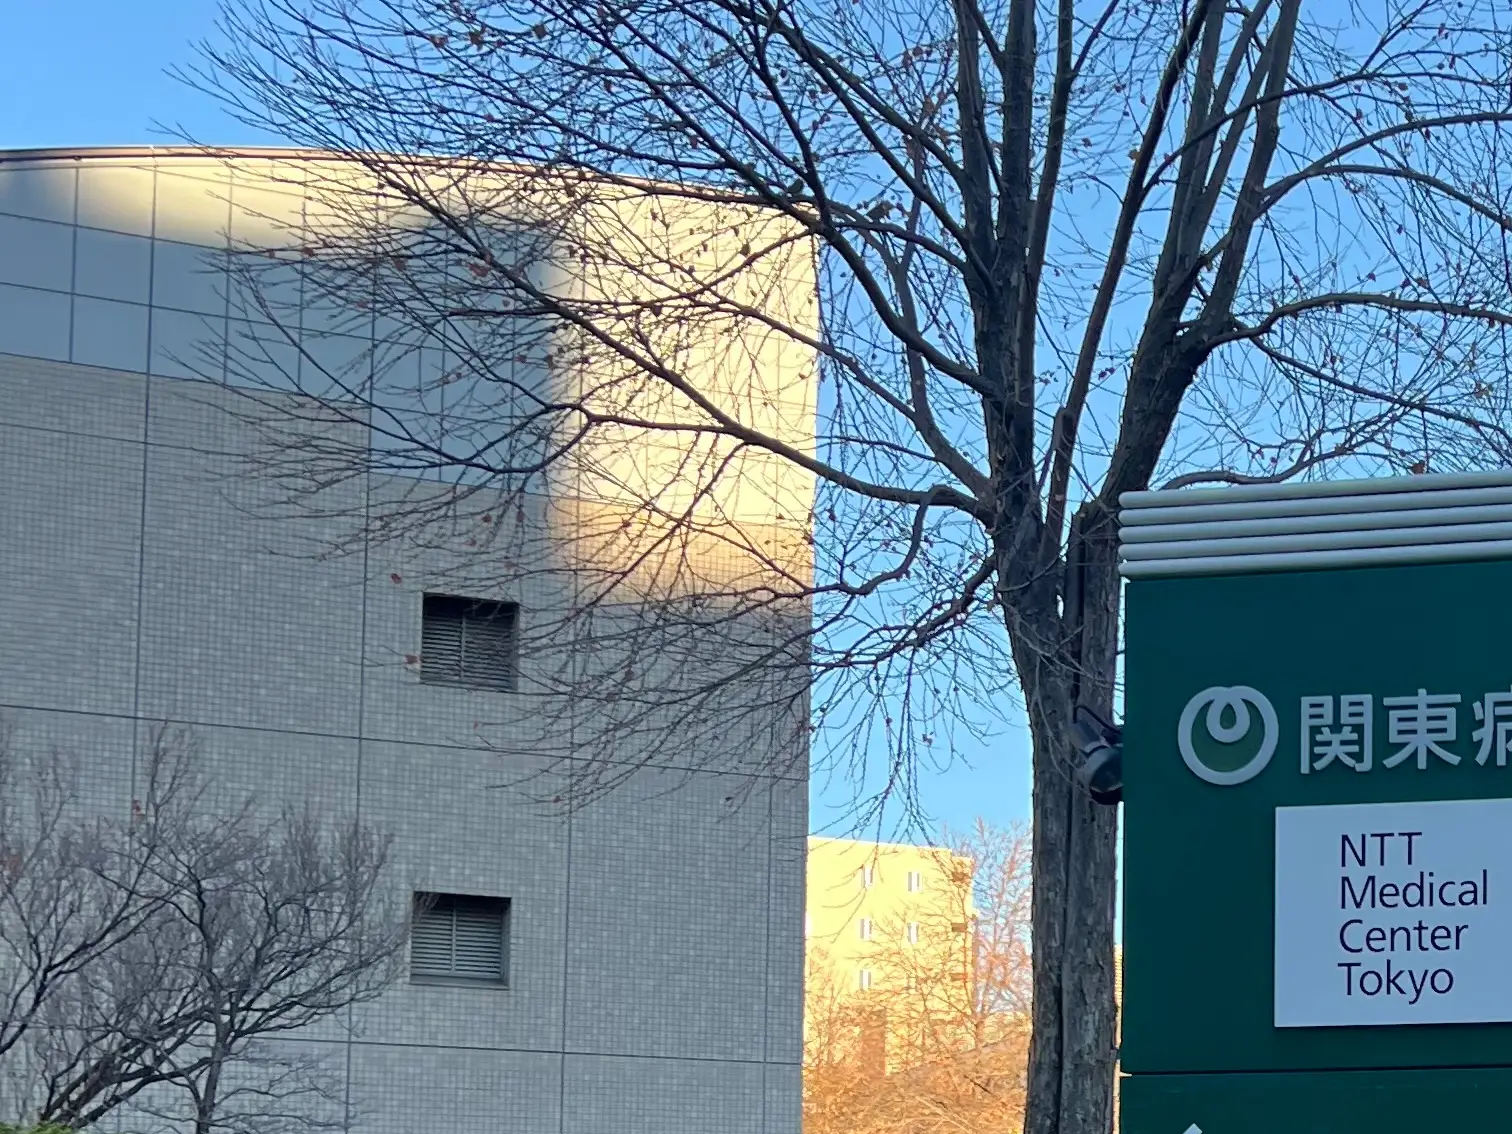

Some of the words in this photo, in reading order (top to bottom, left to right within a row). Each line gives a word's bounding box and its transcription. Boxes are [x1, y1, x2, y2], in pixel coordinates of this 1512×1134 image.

[1340, 832, 1423, 868] NTT
[1340, 870, 1489, 910] Medical
[1339, 919, 1469, 954] Center
[1337, 960, 1455, 1005] Tokyo
